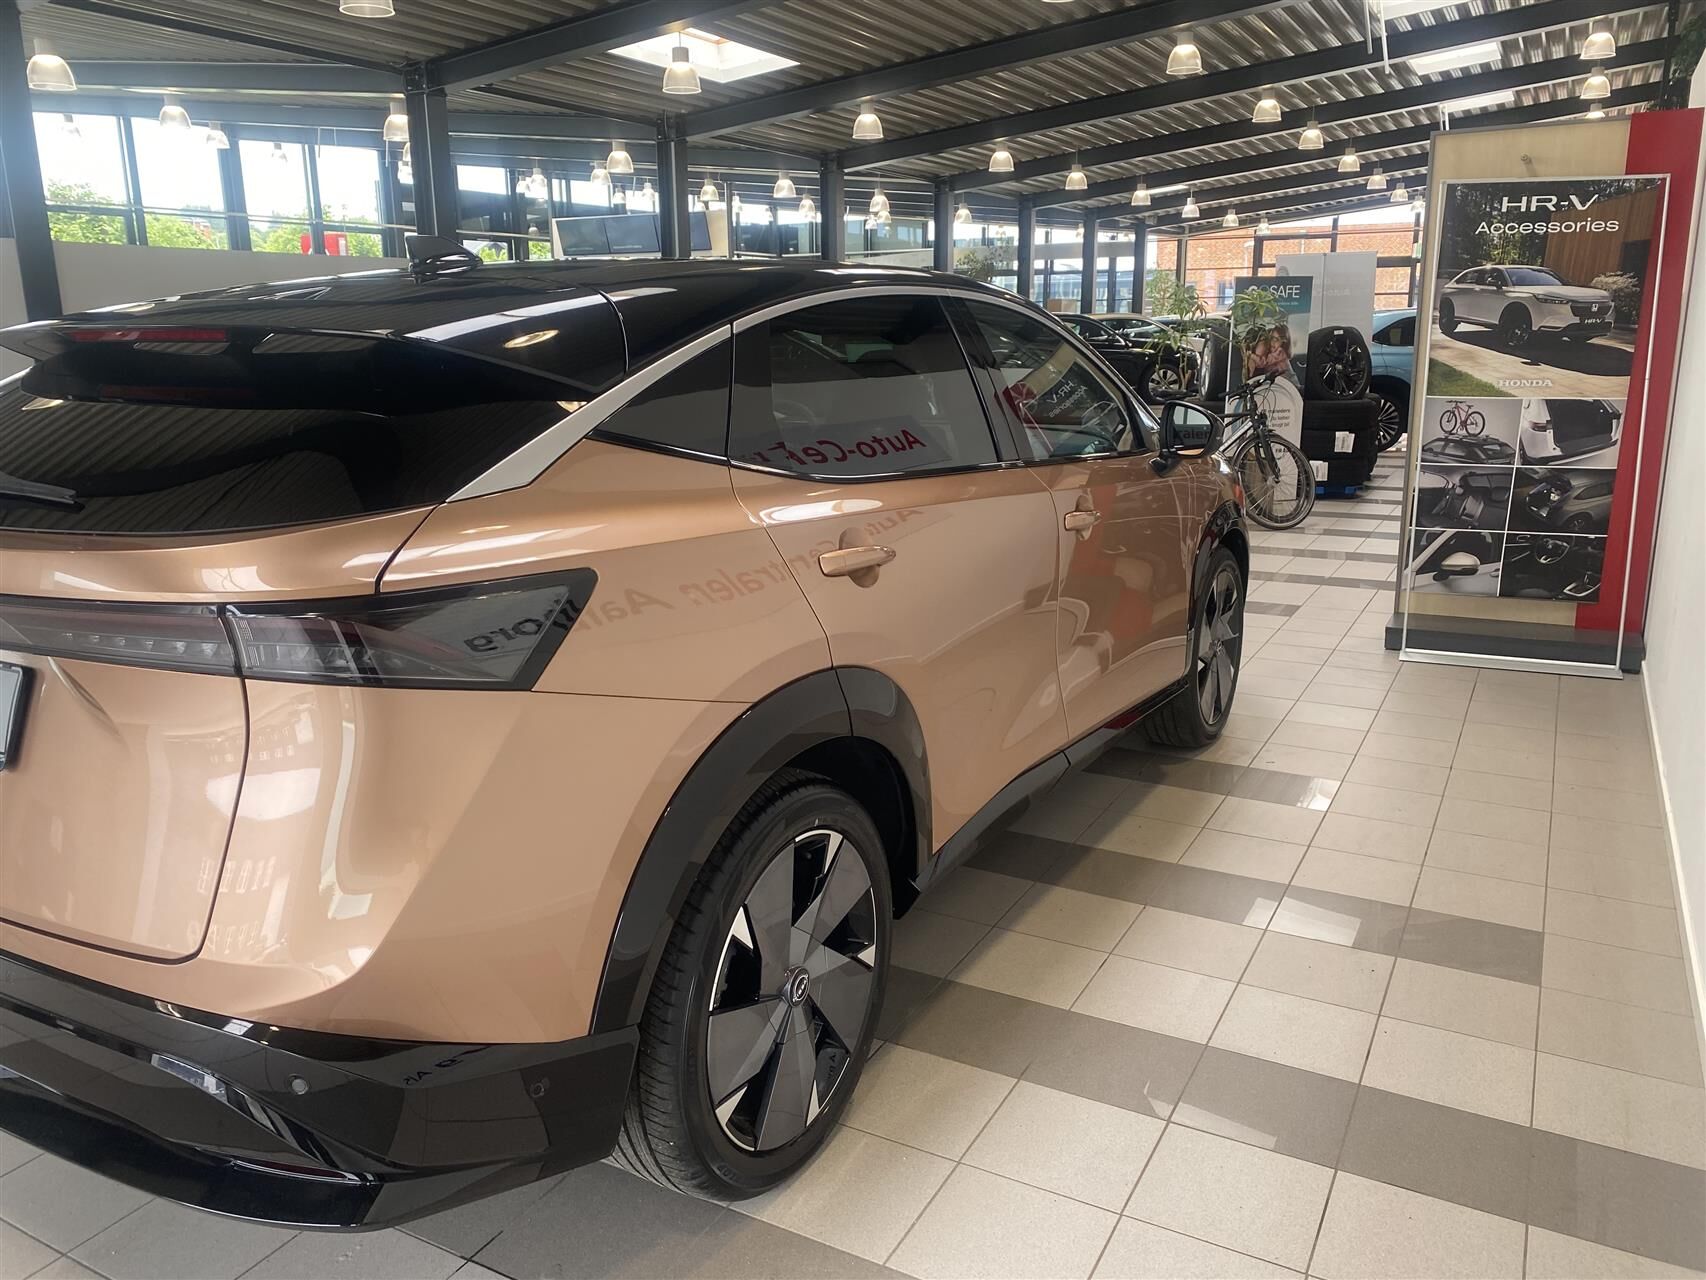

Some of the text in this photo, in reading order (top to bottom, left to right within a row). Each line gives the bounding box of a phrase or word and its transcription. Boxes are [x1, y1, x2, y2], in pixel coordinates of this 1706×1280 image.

[1501, 193, 1599, 212] HR-V
[1474, 218, 1620, 235] Accessories
[1497, 379, 1553, 387] HONDA
